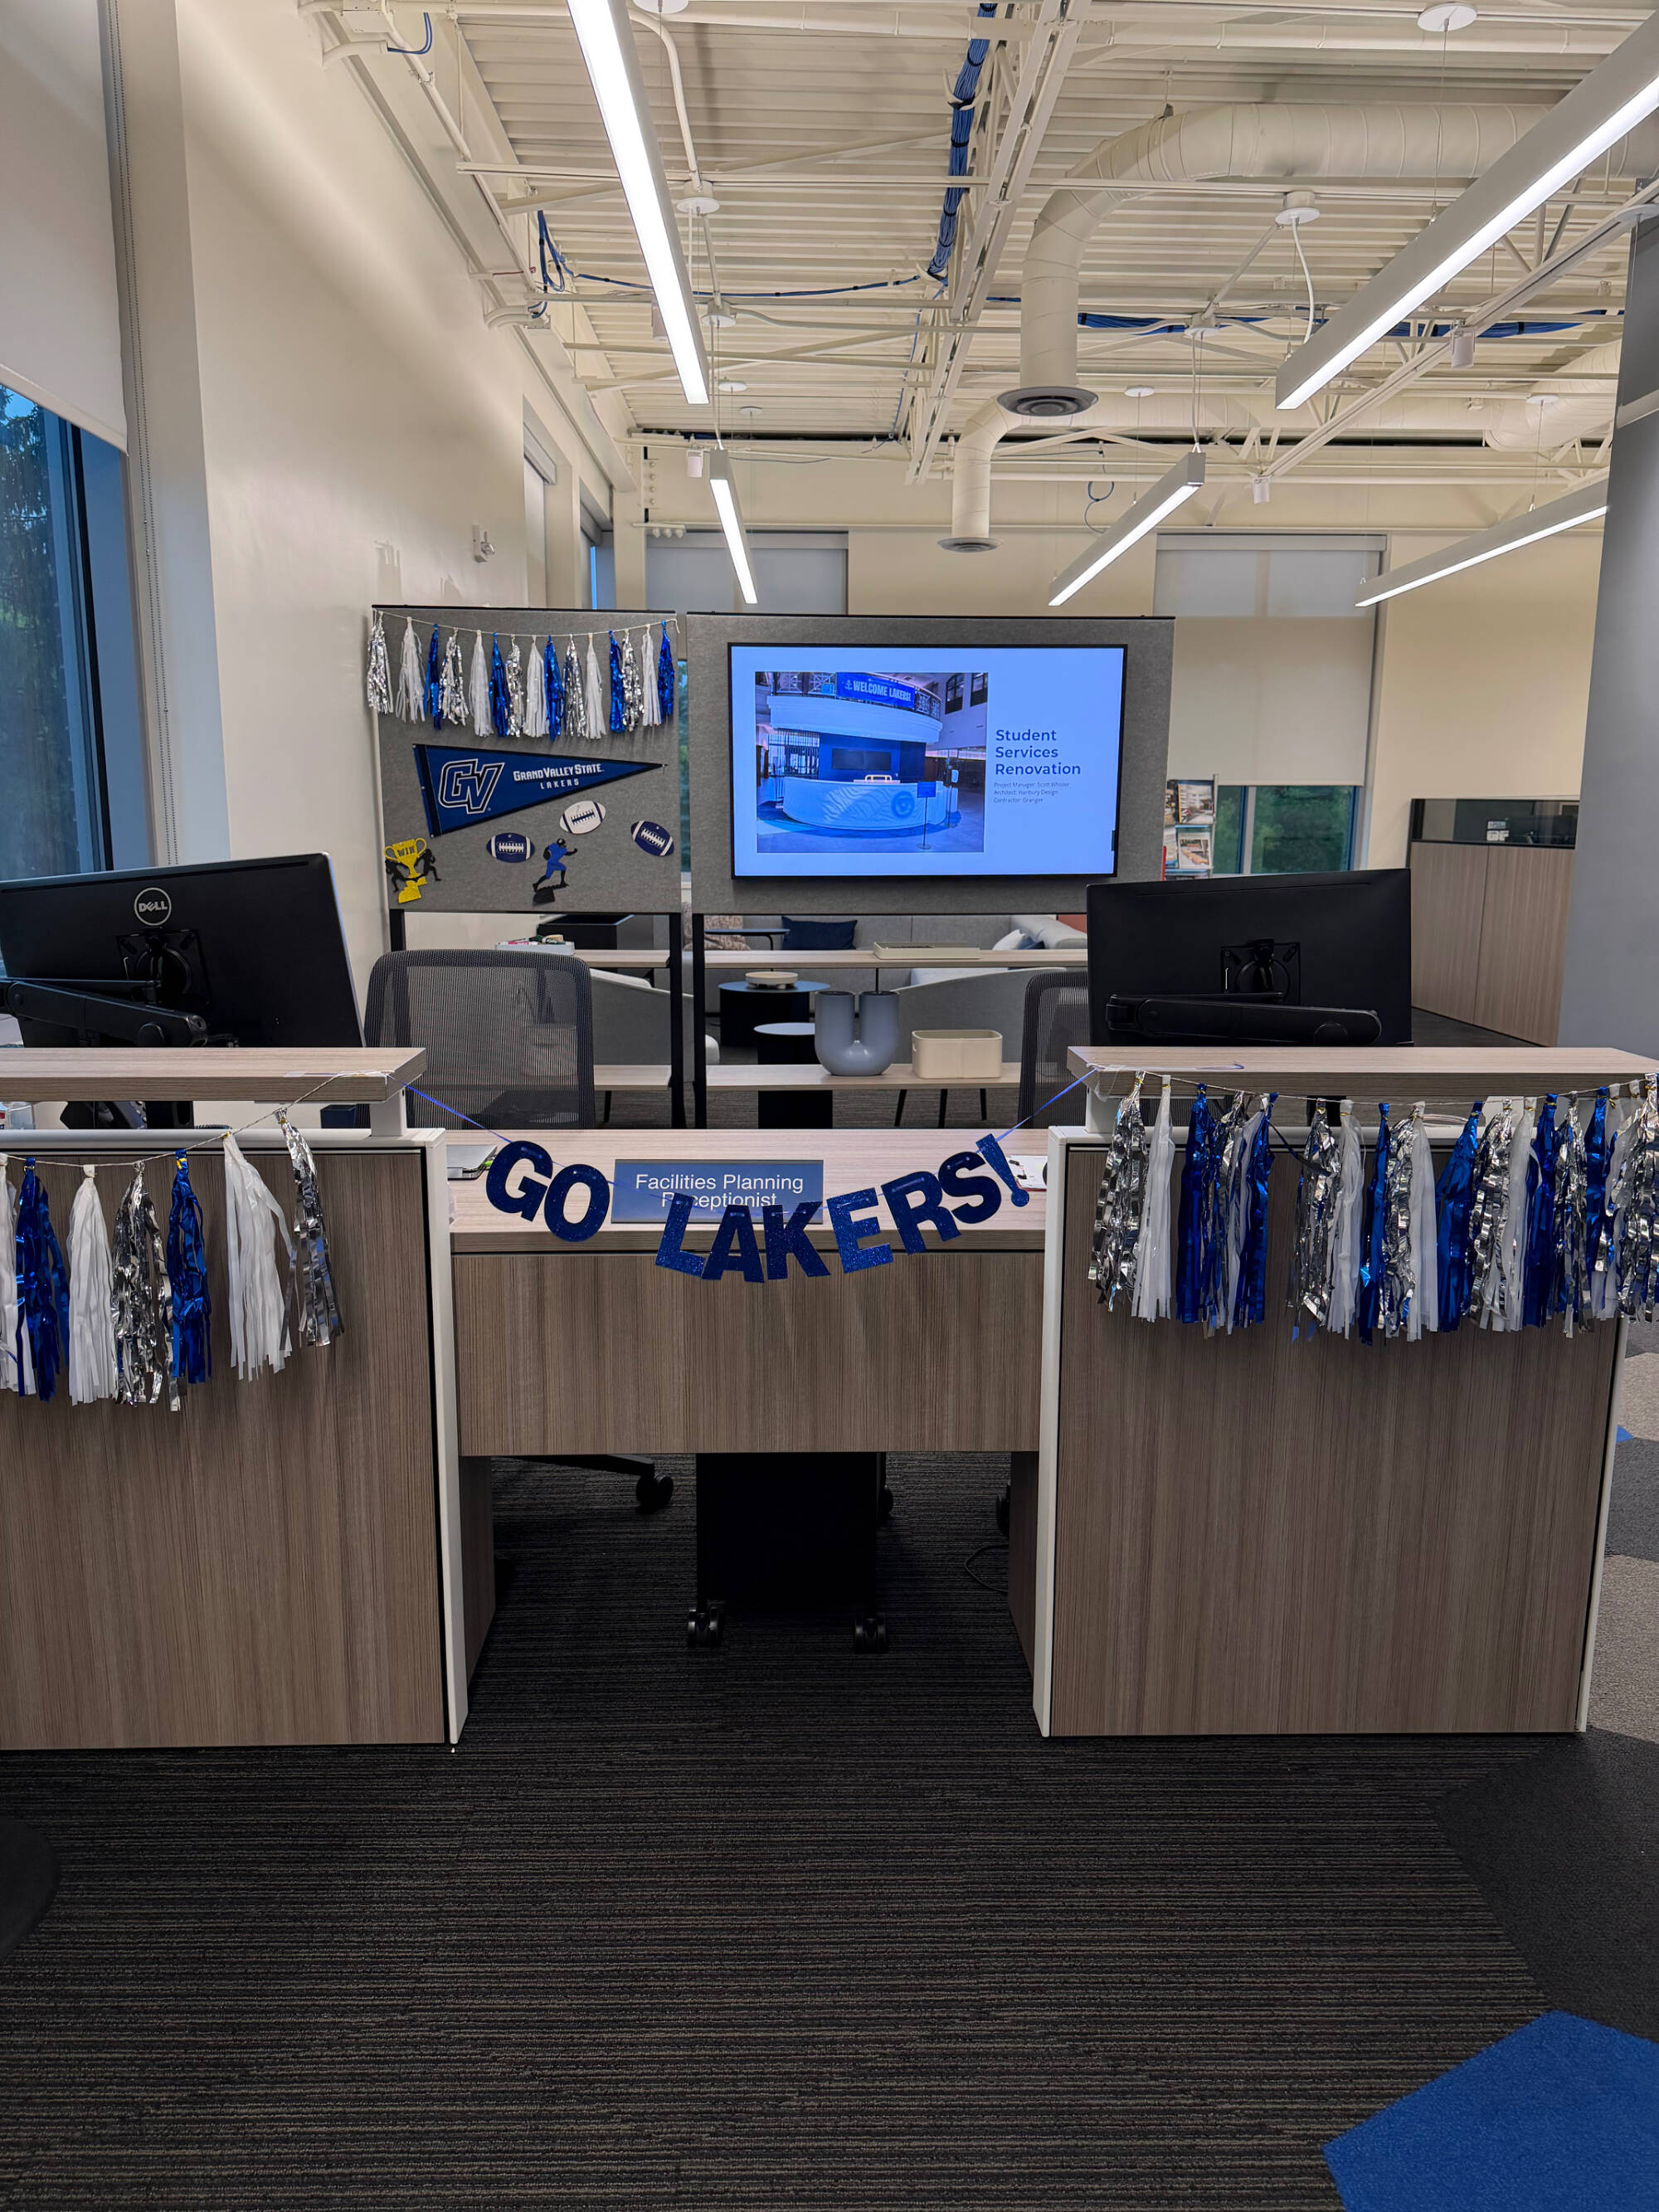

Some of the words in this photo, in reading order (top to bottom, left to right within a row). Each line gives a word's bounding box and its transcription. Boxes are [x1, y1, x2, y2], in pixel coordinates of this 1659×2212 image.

[853, 680, 888, 696] WELCOME
[889, 688, 912, 702] LAKERS!
[995, 728, 1057, 741] Student
[995, 745, 1058, 758] Services
[995, 763, 1081, 775] Renovation
[438, 758, 505, 814] GV
[540, 778, 579, 790] LAKERS
[397, 845, 416, 856] WIN
[139, 901, 168, 912] DELL
[635, 1174, 717, 1190] Facilities
[723, 1174, 804, 1194] Planning
[662, 1191, 777, 1211] Rceptionist
[485, 1140, 611, 1242] GO
[655, 1133, 1029, 1284] LAKERS!
